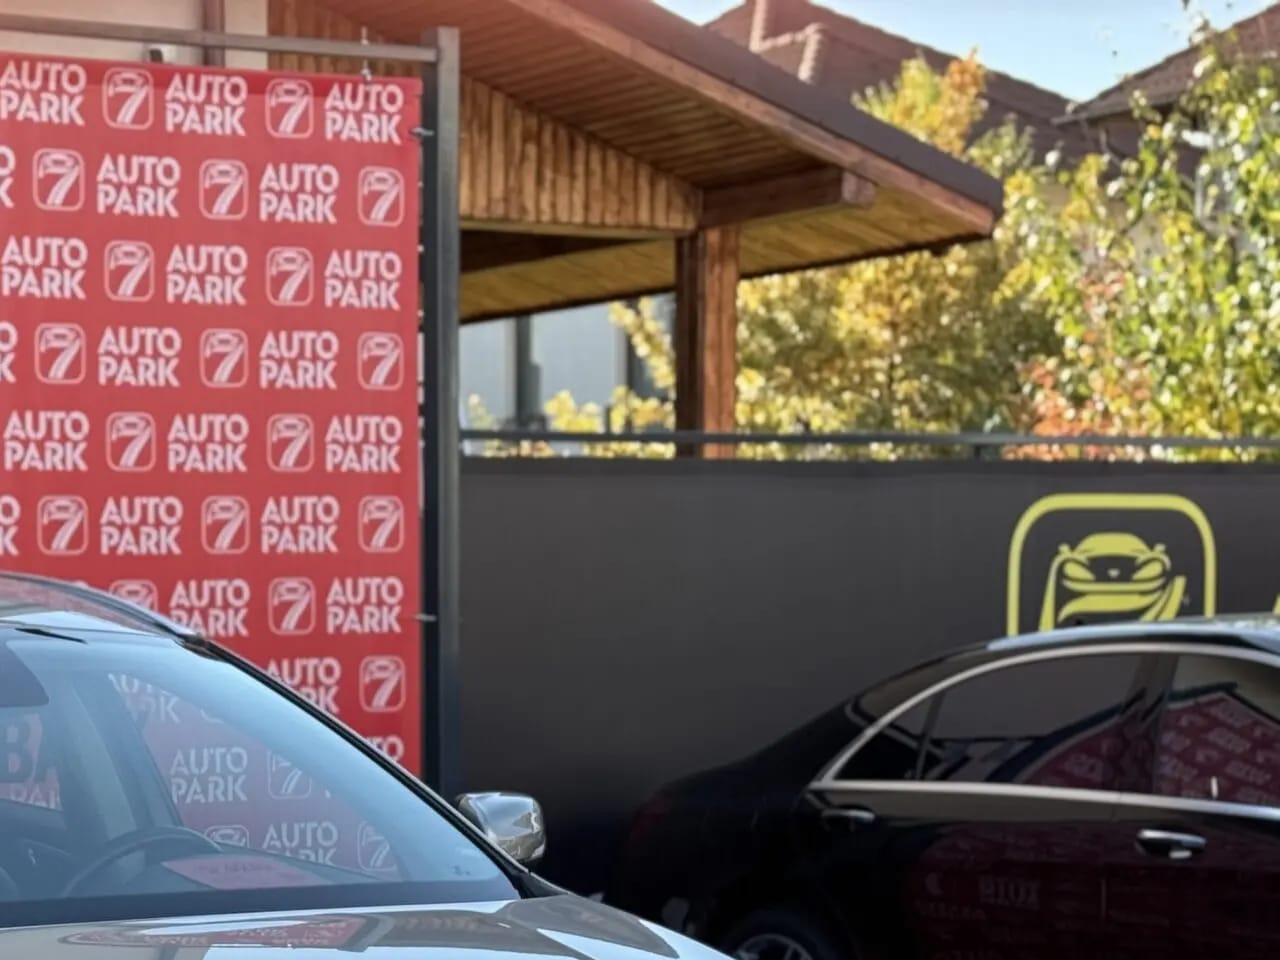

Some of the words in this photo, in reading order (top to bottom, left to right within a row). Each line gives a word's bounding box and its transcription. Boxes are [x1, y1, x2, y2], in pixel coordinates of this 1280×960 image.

[0, 62, 85, 94] AUTO
[166, 75, 246, 106] AUTO
[0, 90, 84, 124] PARK
[325, 84, 403, 115] AUTO
[166, 103, 244, 136] PARK
[326, 112, 400, 143] PARK
[98, 155, 180, 186] AUTO
[260, 164, 338, 193] AUTO
[98, 184, 178, 216] PARK
[260, 192, 336, 222] PARK
[2, 237, 87, 268] AUTO
[167, 246, 247, 274] AUTO
[326, 251, 401, 280] AUTO
[3, 266, 84, 298] PARK
[168, 274, 244, 304] PARK
[326, 279, 398, 309] PARK
[98, 328, 180, 356] AUTO
[260, 332, 338, 359] AUTO
[100, 356, 178, 386] PARK
[261, 360, 336, 388] PARK
[4, 412, 89, 440] AUTO
[168, 414, 248, 442] AUTO
[326, 416, 402, 444] AUTO
[5, 440, 86, 470] PARK
[169, 444, 246, 471] PARK
[326, 444, 400, 472] PARK
[101, 497, 182, 524] AUTO
[262, 496, 338, 523] AUTO
[102, 526, 180, 554] PARK
[262, 525, 336, 552] PARK
[170, 579, 250, 607] AUTO
[327, 577, 402, 604] AUTO
[328, 606, 400, 632] PARK
[170, 748, 248, 776] AUTO
[171, 774, 248, 804] PARK
[263, 821, 338, 849] AUTO
